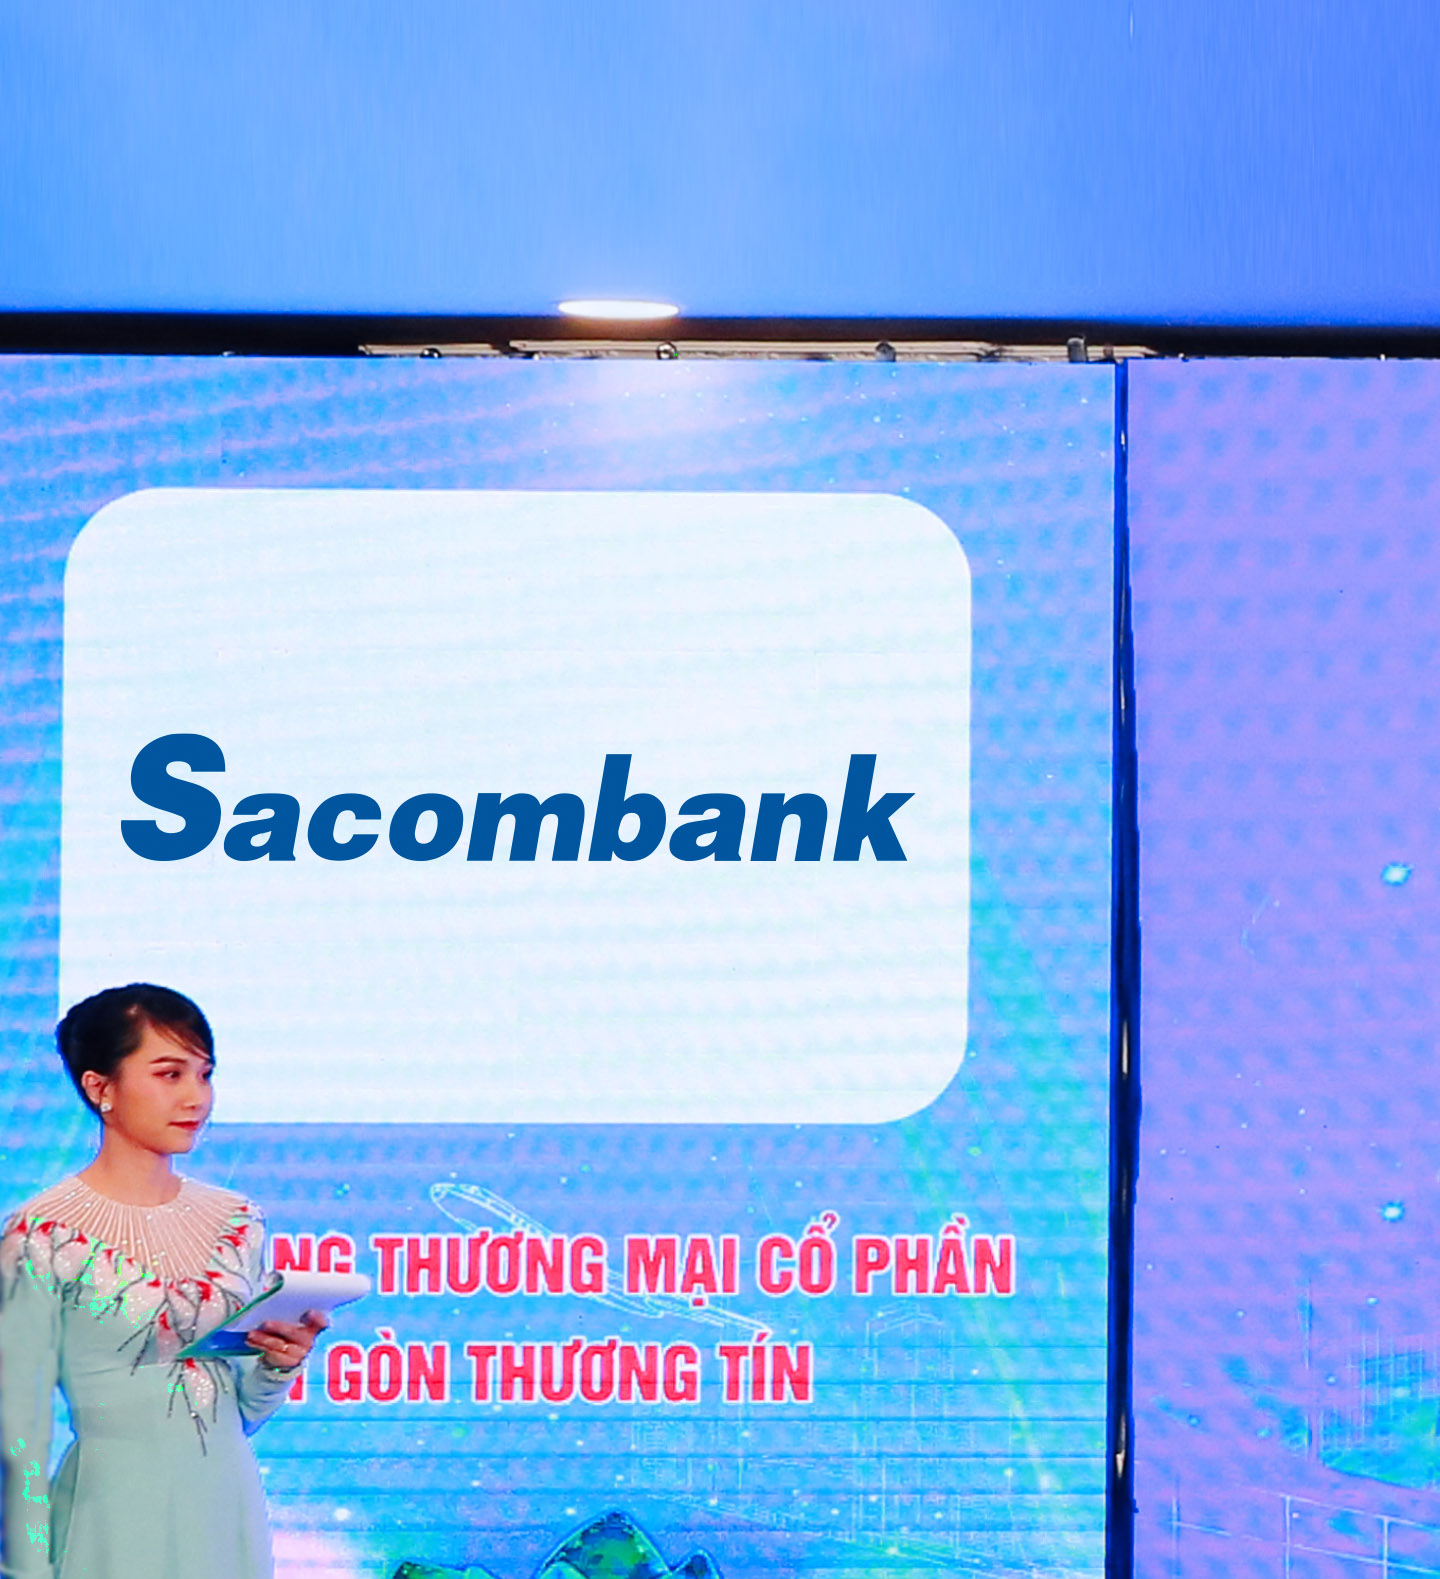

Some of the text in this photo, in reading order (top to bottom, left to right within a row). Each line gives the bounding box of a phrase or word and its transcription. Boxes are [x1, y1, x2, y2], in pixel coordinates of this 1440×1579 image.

[121, 733, 915, 862] Sacombank
[372, 1229, 606, 1295] THƯƠNG
[625, 1234, 739, 1309] MẠI
[758, 1211, 838, 1298] CỔ
[855, 1214, 1016, 1297] PHẦN
[327, 1329, 447, 1403] GÒN
[466, 1336, 698, 1403] THƯƠNG
[720, 1329, 813, 1403] TÍN
